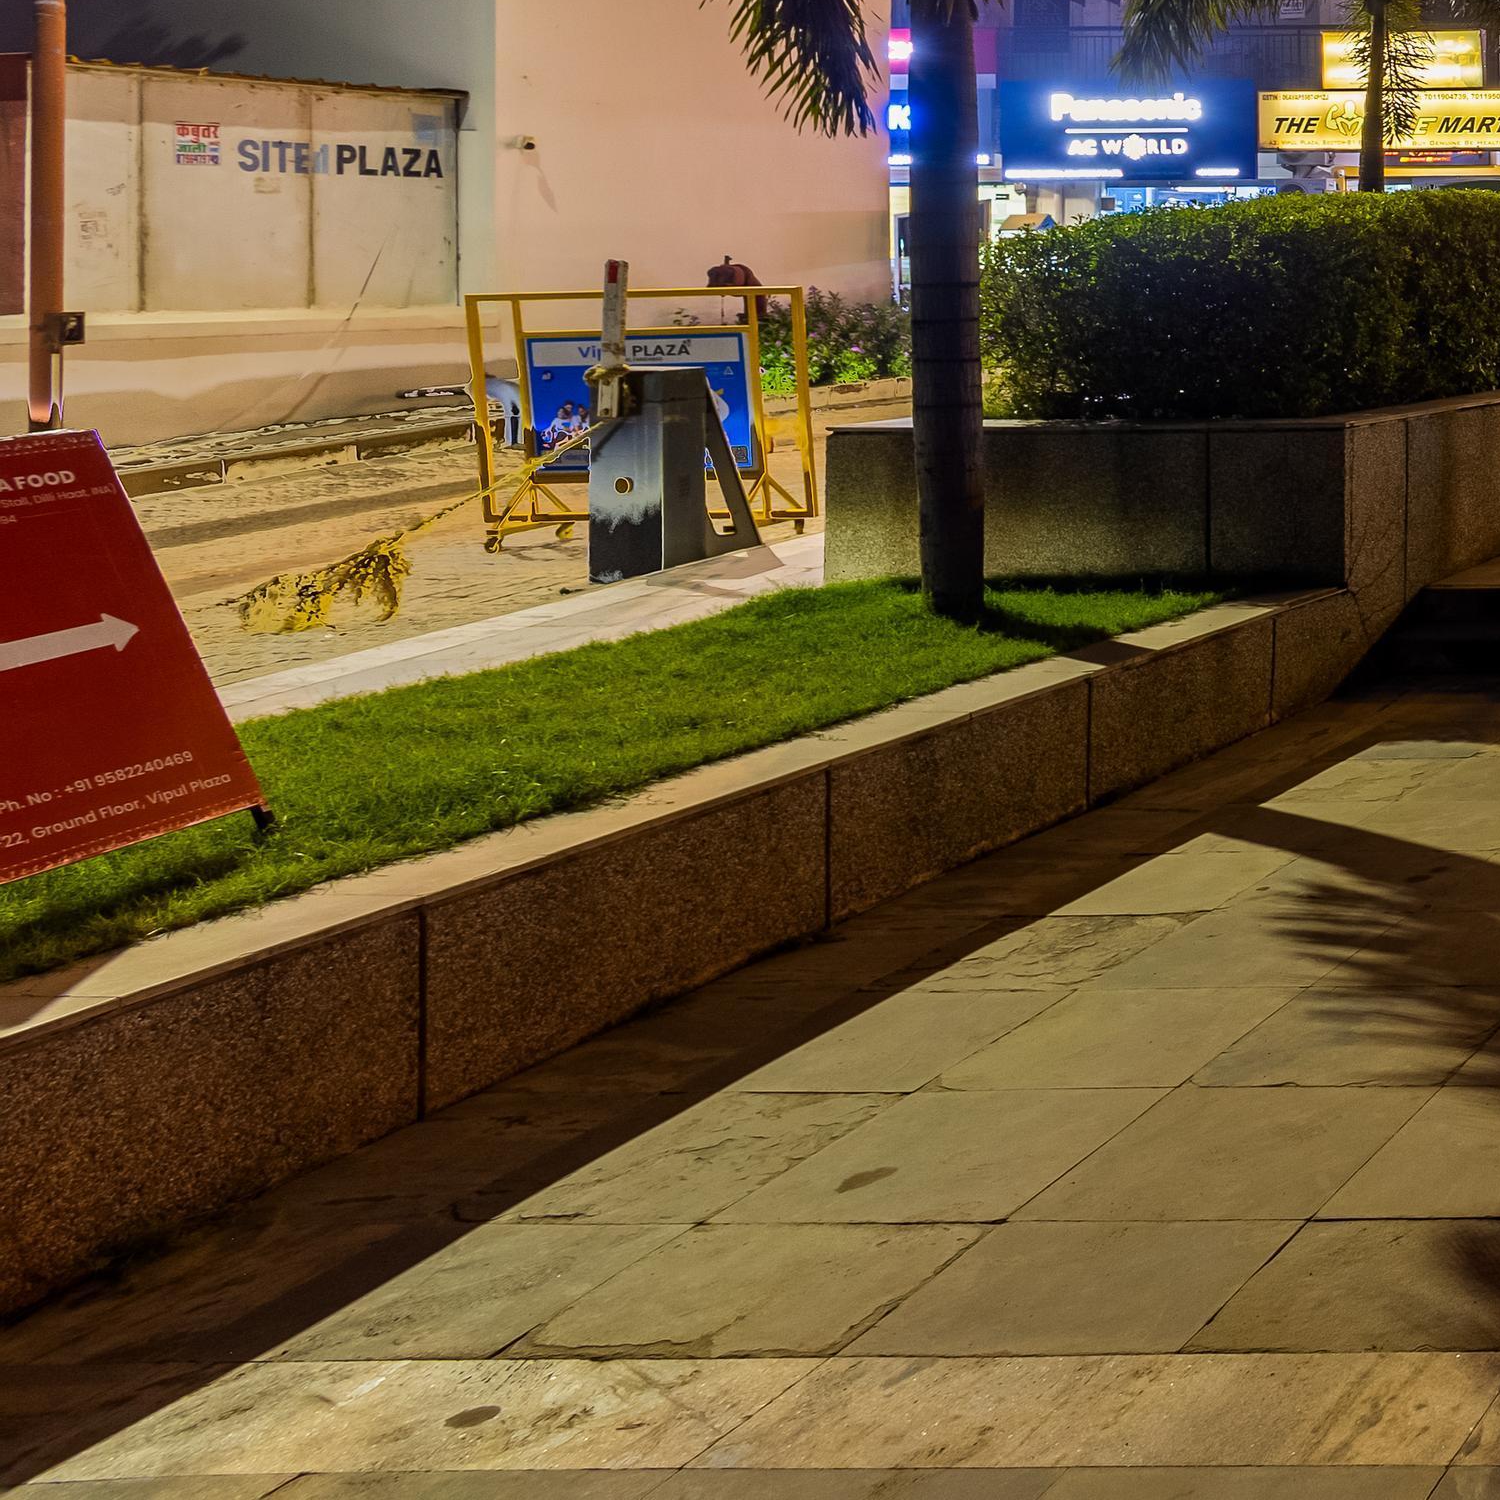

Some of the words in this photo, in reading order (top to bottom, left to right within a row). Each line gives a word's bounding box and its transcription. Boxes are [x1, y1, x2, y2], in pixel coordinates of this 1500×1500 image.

[1274, 116, 1320, 134] THE
[237, 140, 310, 174] SITE
[335, 145, 443, 178] PLAZA
[631, 343, 691, 357] PLAZA
[14, 470, 76, 490] FOOD
[26, 792, 53, 806] No
[63, 777, 92, 795] +91
[94, 750, 194, 788] 9582240469
[31, 809, 98, 839] Ground
[99, 797, 147, 819] Floor,
[146, 784, 188, 804] Vipul
[190, 773, 232, 793] Plaza
